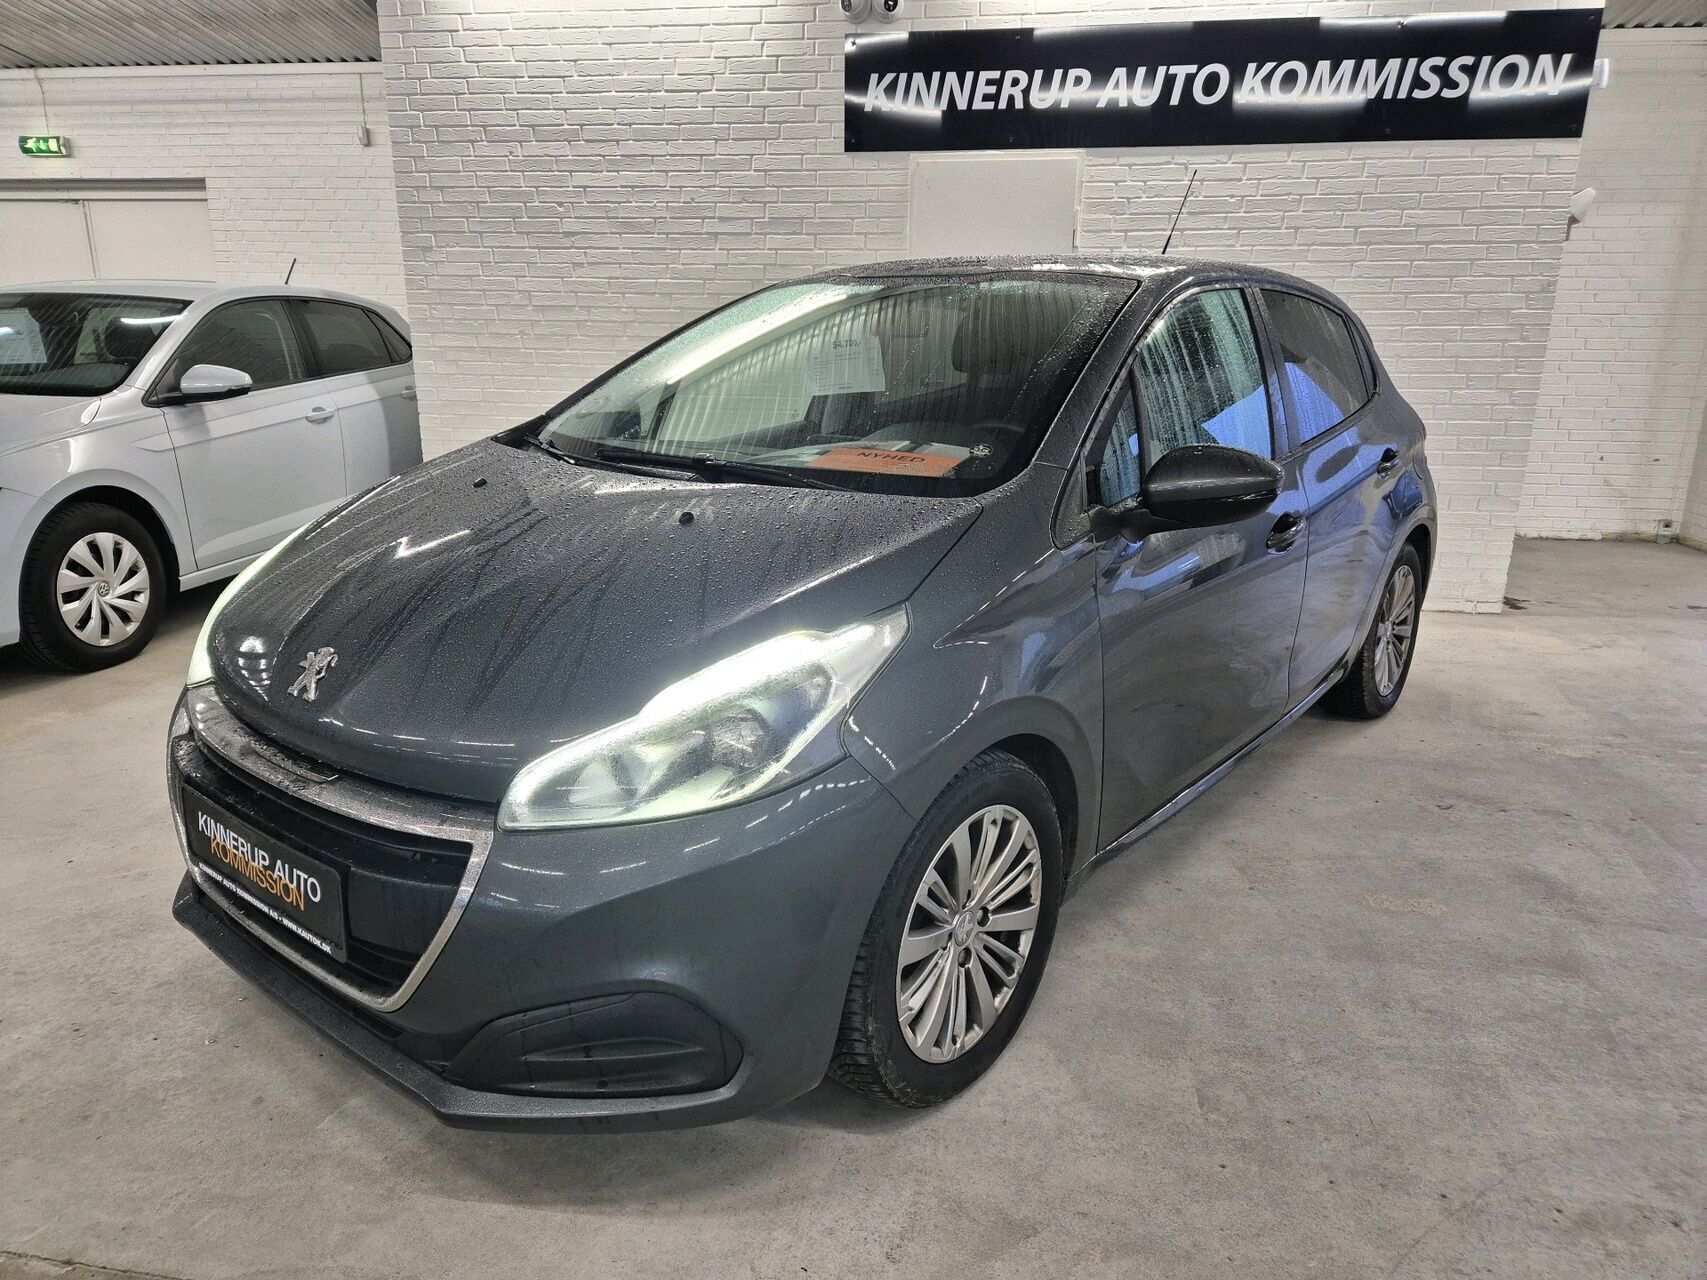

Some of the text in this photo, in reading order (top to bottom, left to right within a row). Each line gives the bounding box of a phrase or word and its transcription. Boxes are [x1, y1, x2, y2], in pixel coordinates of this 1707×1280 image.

[864, 53, 1573, 112] KINNERUP AUTO KOMMISSION
[857, 452, 926, 462] NYHED
[198, 811, 321, 903] KINNERUP AUTO
[210, 837, 305, 911] KOMMISSION
